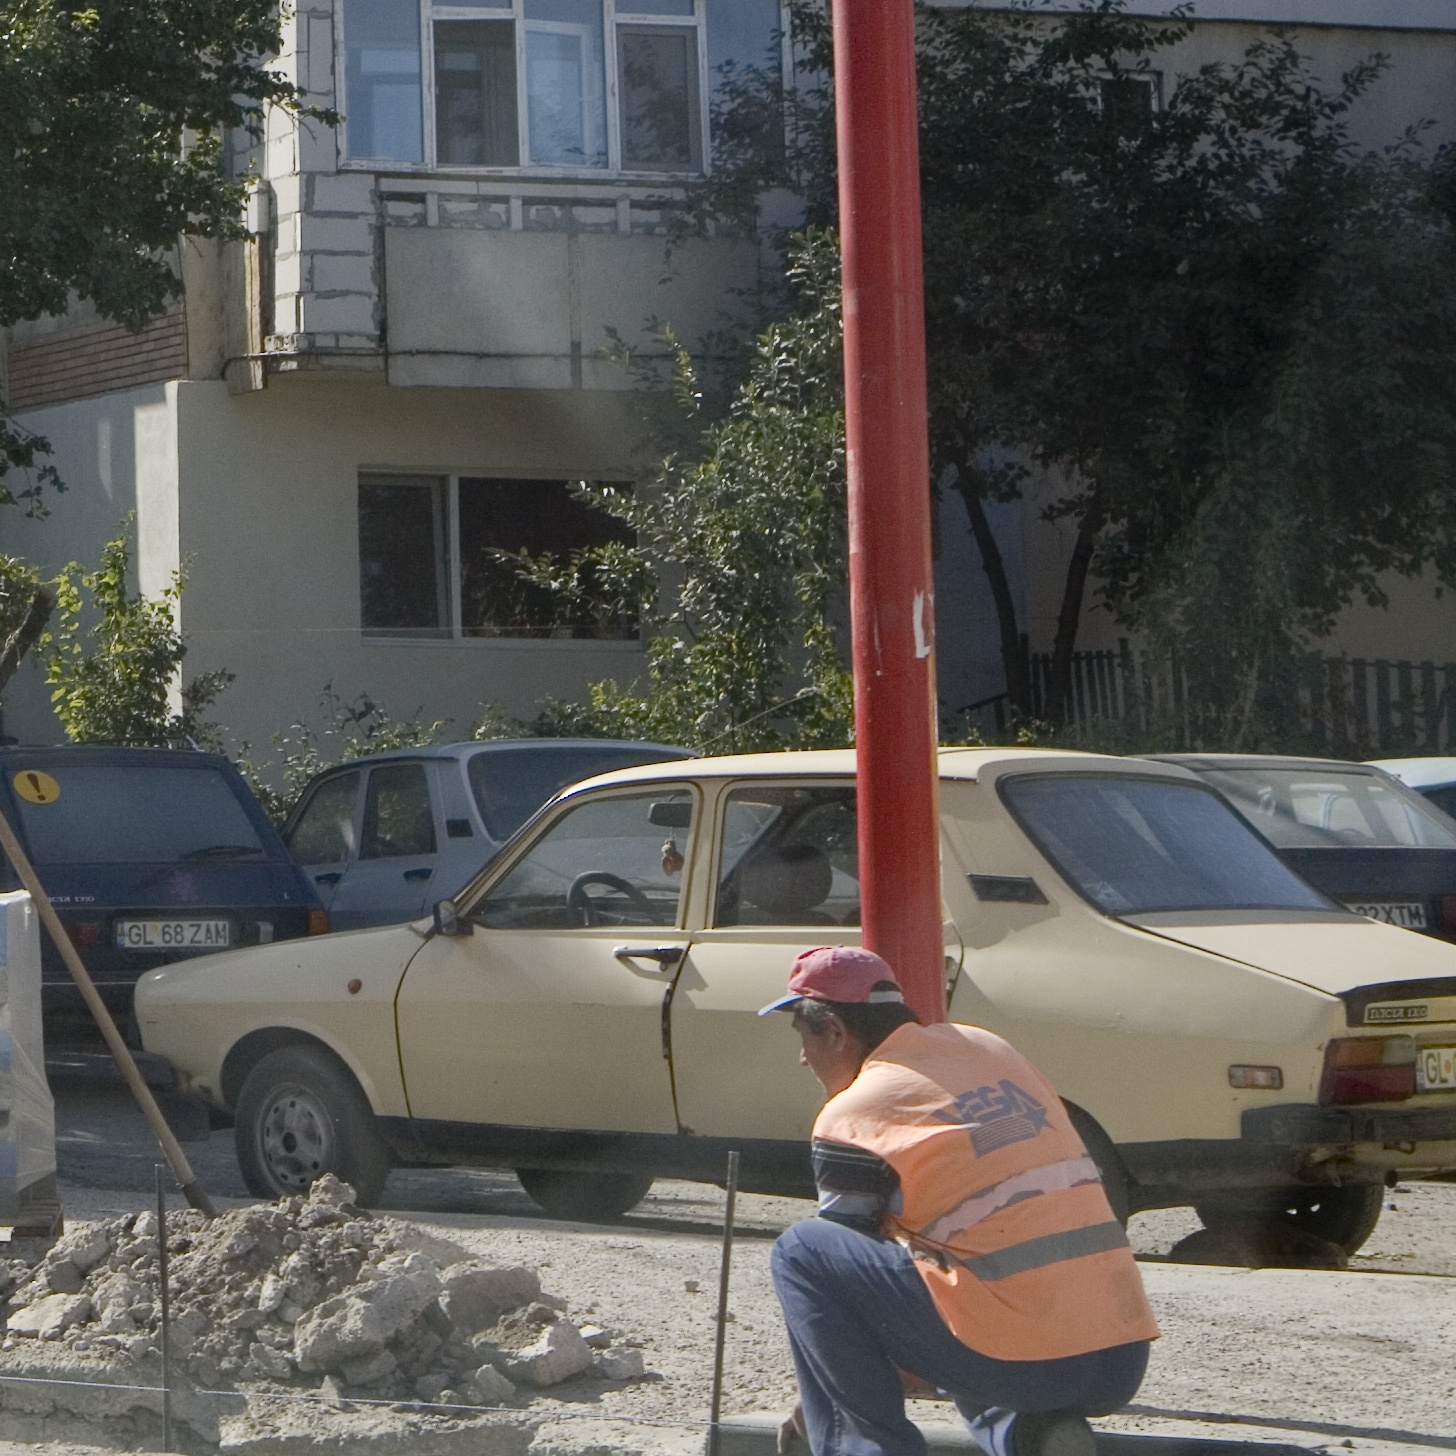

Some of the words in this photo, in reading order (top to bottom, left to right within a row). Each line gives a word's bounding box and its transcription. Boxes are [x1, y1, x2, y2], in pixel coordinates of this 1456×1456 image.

[128, 924, 155, 945] GL
[161, 923, 185, 945] 68
[189, 922, 229, 945] ZAM
[1425, 1051, 1449, 1084] GL
